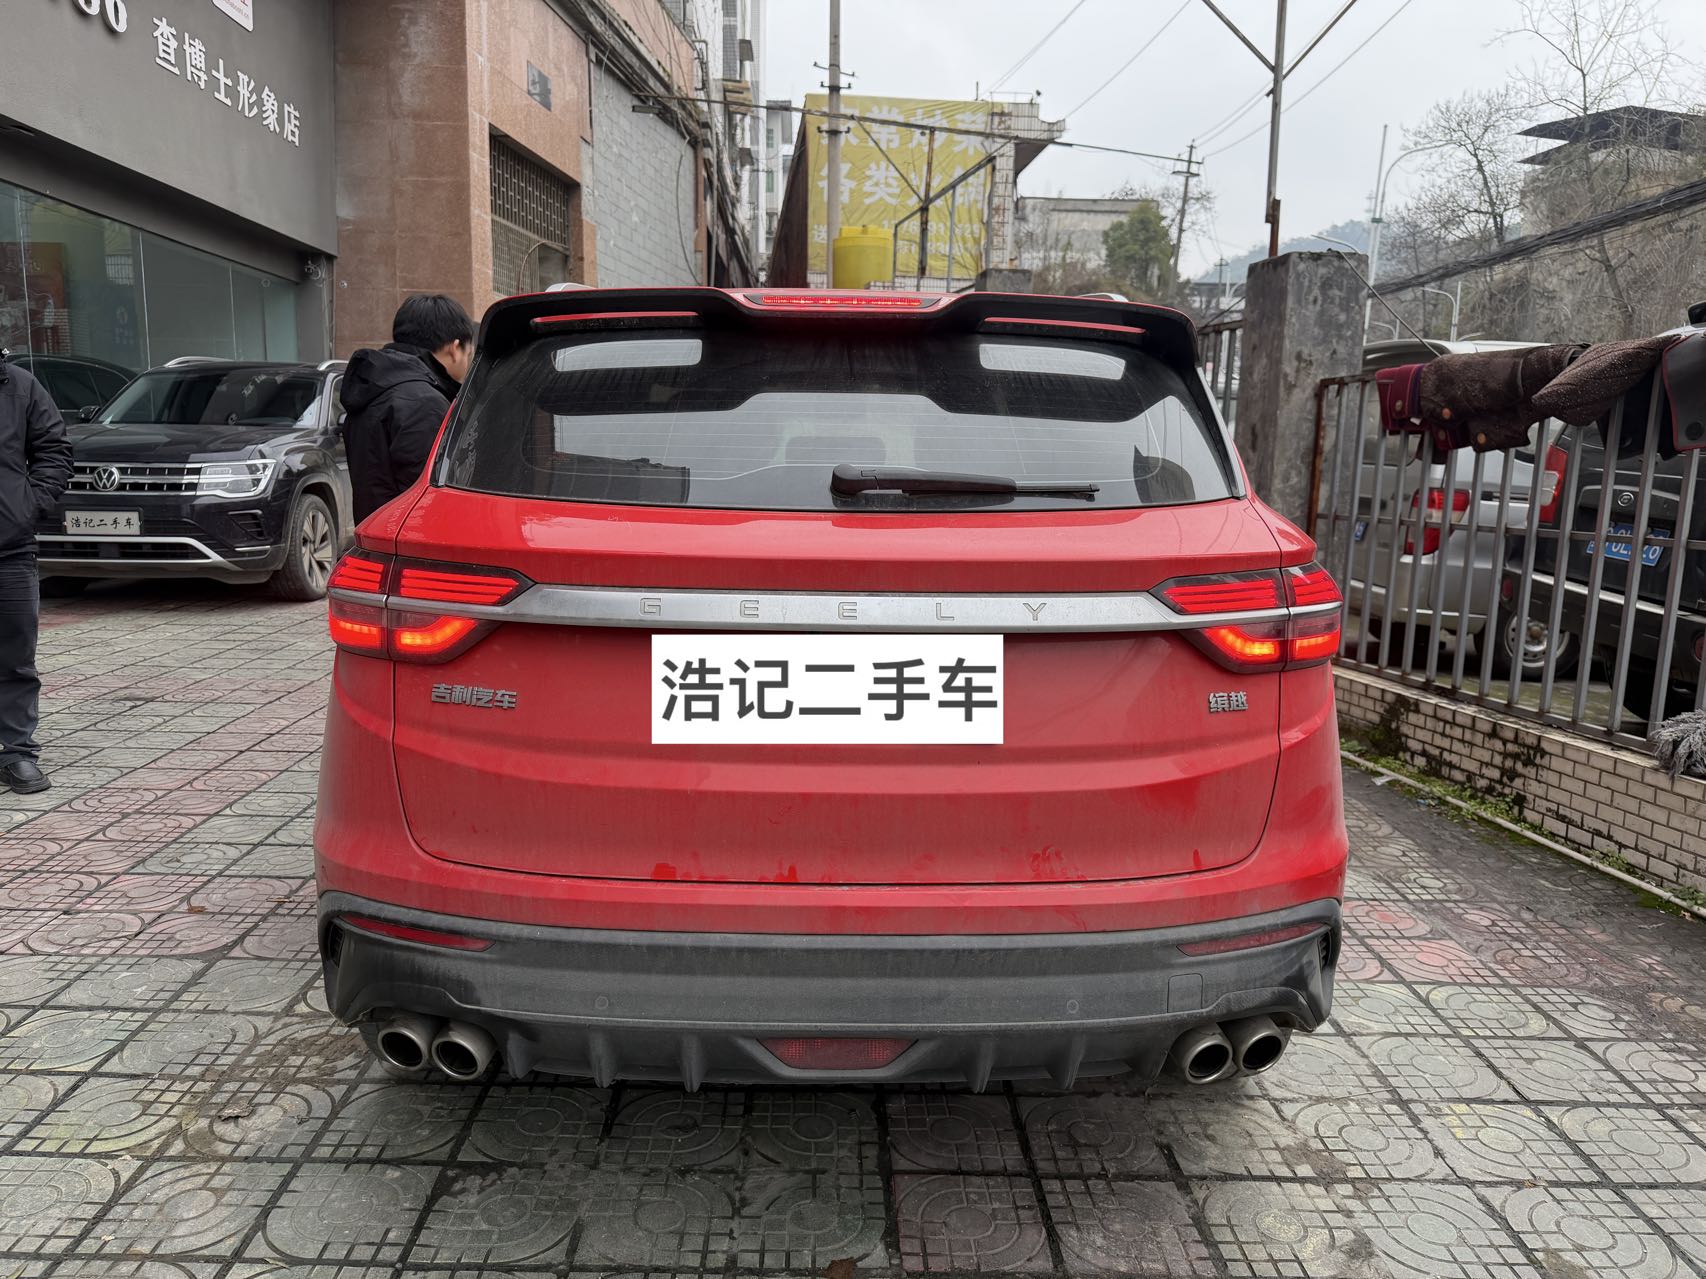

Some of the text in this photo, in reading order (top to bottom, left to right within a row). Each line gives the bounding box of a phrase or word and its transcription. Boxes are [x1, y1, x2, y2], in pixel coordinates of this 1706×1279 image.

[153, 17, 301, 147] 查博士形象店
[70, 516, 135, 530] 浩记二手车
[639, 597, 1047, 622] GEELY
[431, 683, 517, 709] 吉利汽车
[1209, 691, 1249, 712] 缤越
